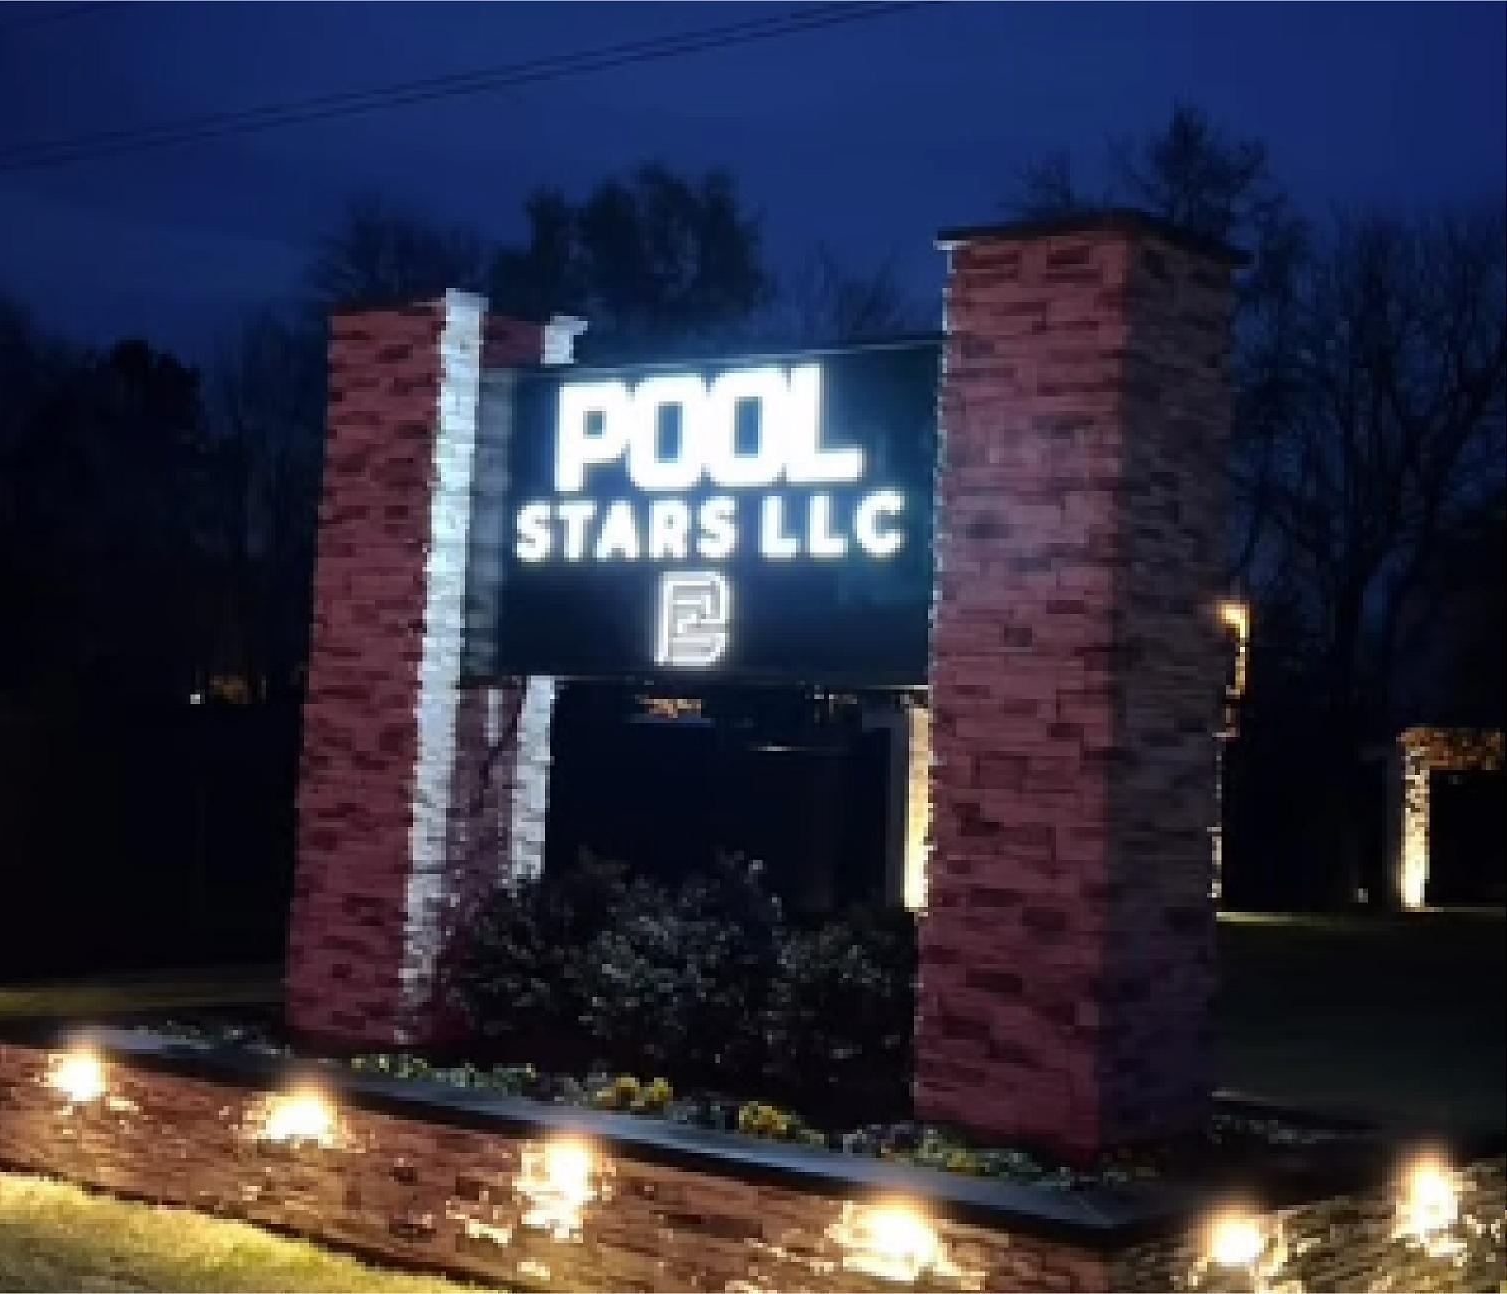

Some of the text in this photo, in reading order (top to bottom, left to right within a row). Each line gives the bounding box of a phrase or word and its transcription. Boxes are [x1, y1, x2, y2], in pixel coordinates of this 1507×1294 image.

[554, 364, 865, 491] POOL
[515, 488, 906, 562] STARS LLC
